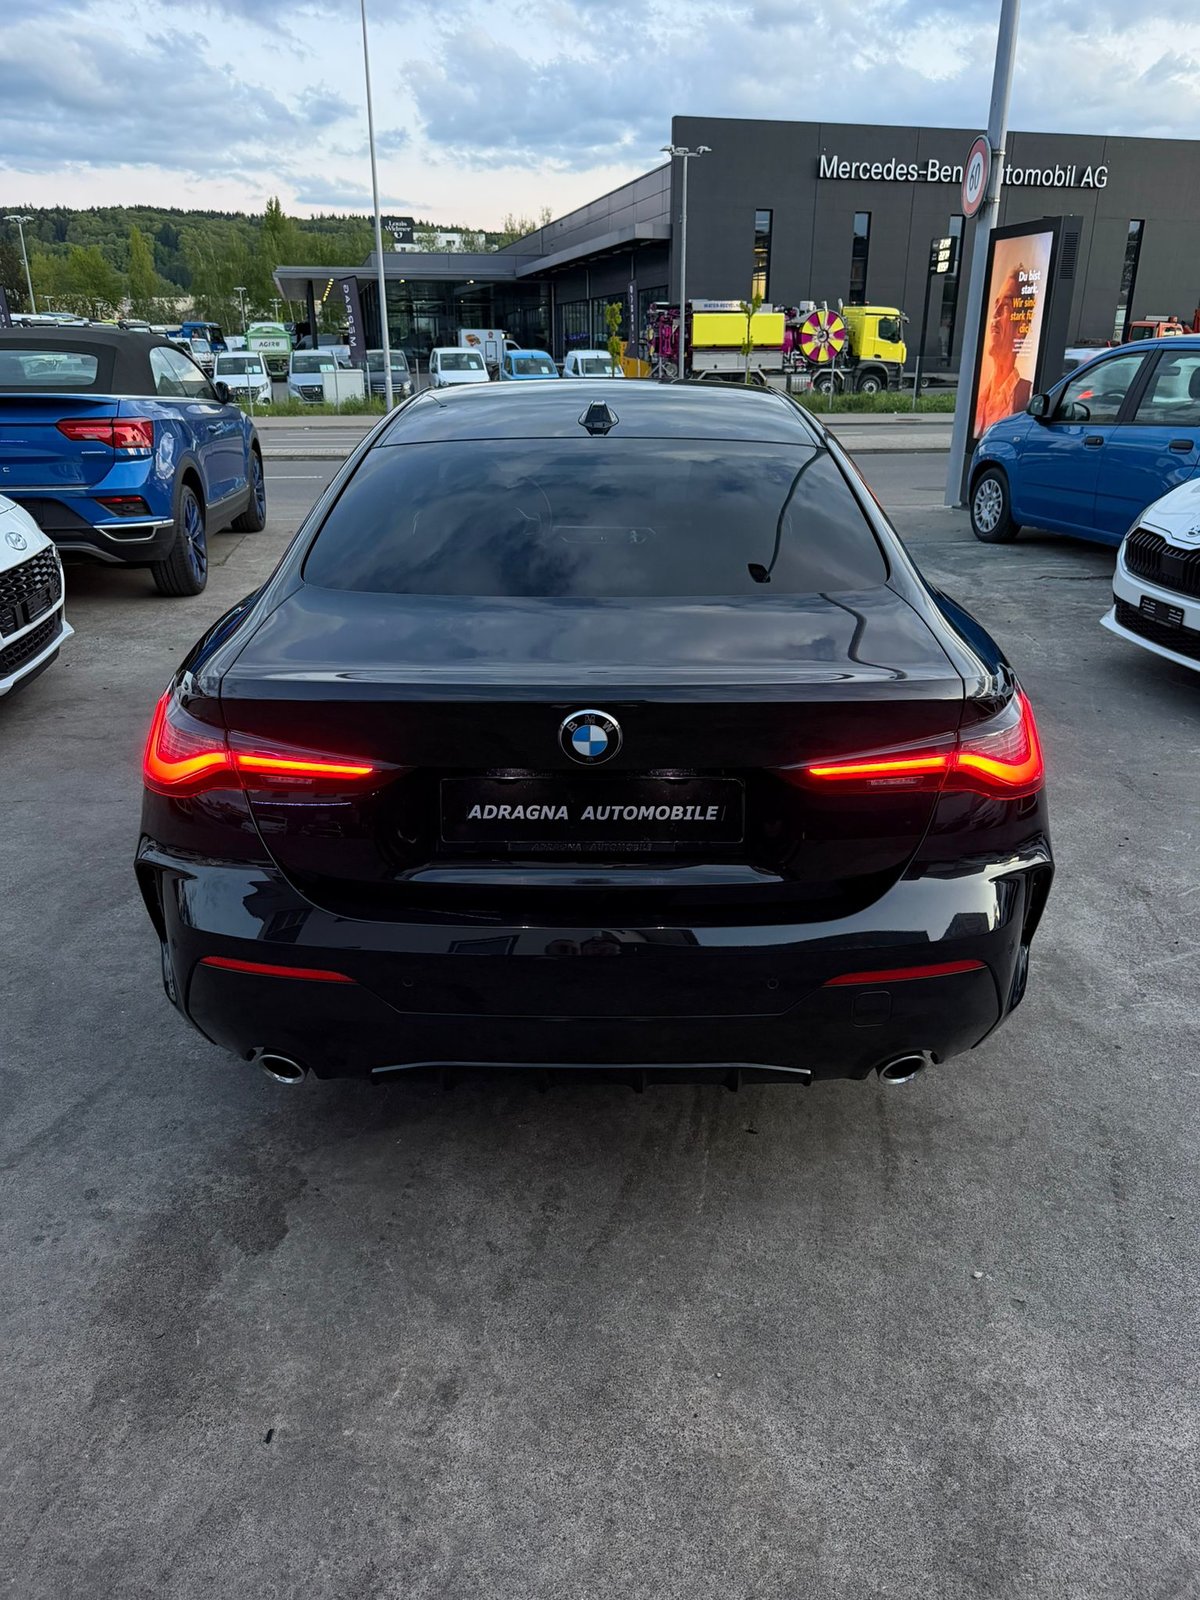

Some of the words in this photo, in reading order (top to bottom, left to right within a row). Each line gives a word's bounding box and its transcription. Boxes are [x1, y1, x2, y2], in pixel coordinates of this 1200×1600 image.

[819, 154, 963, 183] Mercedes-Ben
[1000, 163, 1077, 187] tomobil
[1080, 165, 1108, 188] AG
[968, 162, 981, 192] 60
[1018, 271, 1028, 282] Du
[1028, 269, 1041, 281] bist
[1013, 297, 1023, 308] Wir
[1010, 309, 1025, 321] stark
[566, 714, 615, 733] BMW
[467, 804, 569, 821] ADRAGNA
[580, 805, 719, 821] AUTOMOBILE
